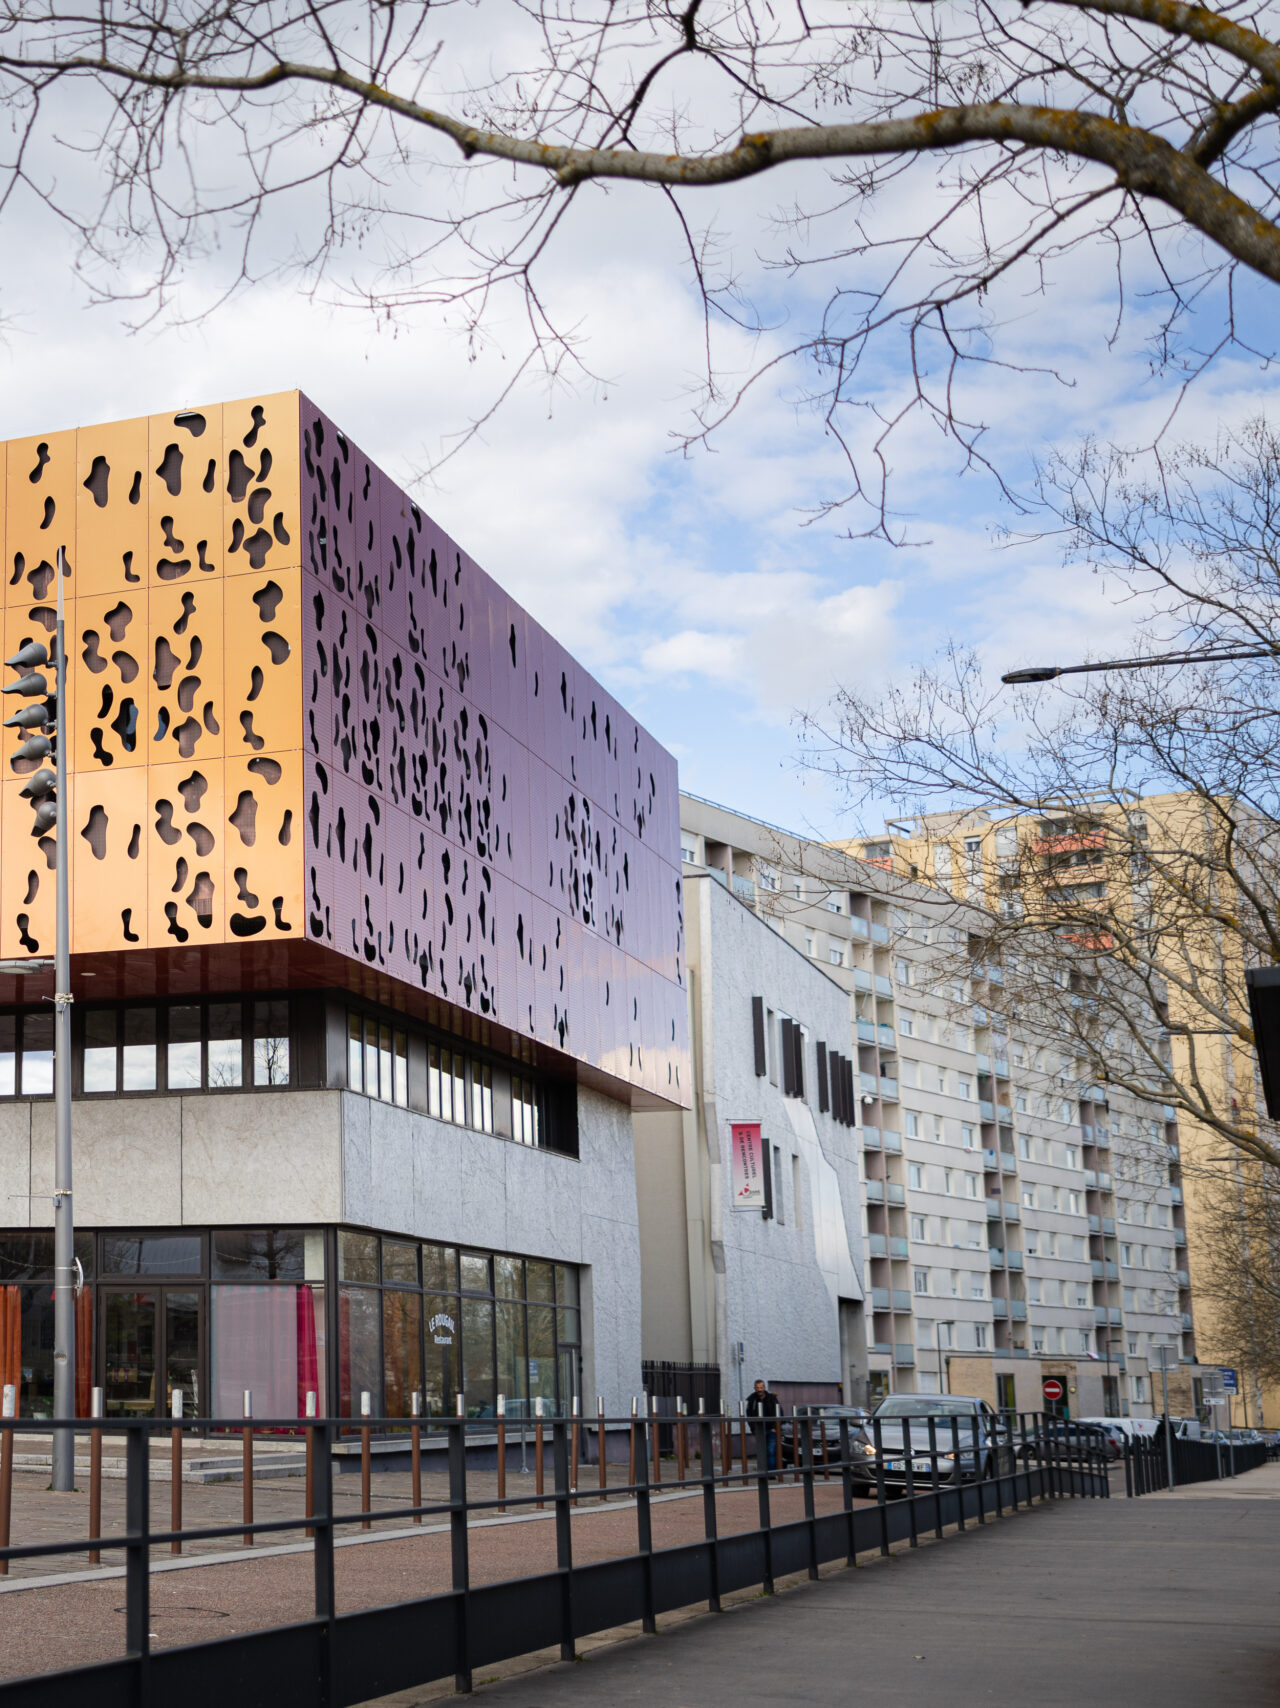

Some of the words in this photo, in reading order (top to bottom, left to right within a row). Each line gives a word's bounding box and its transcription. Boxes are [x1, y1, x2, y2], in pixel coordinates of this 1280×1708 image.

[741, 1145, 749, 1179] RENCONTRES
[749, 1152, 757, 1178] CULTUREL
[428, 1316, 436, 1333] LE
